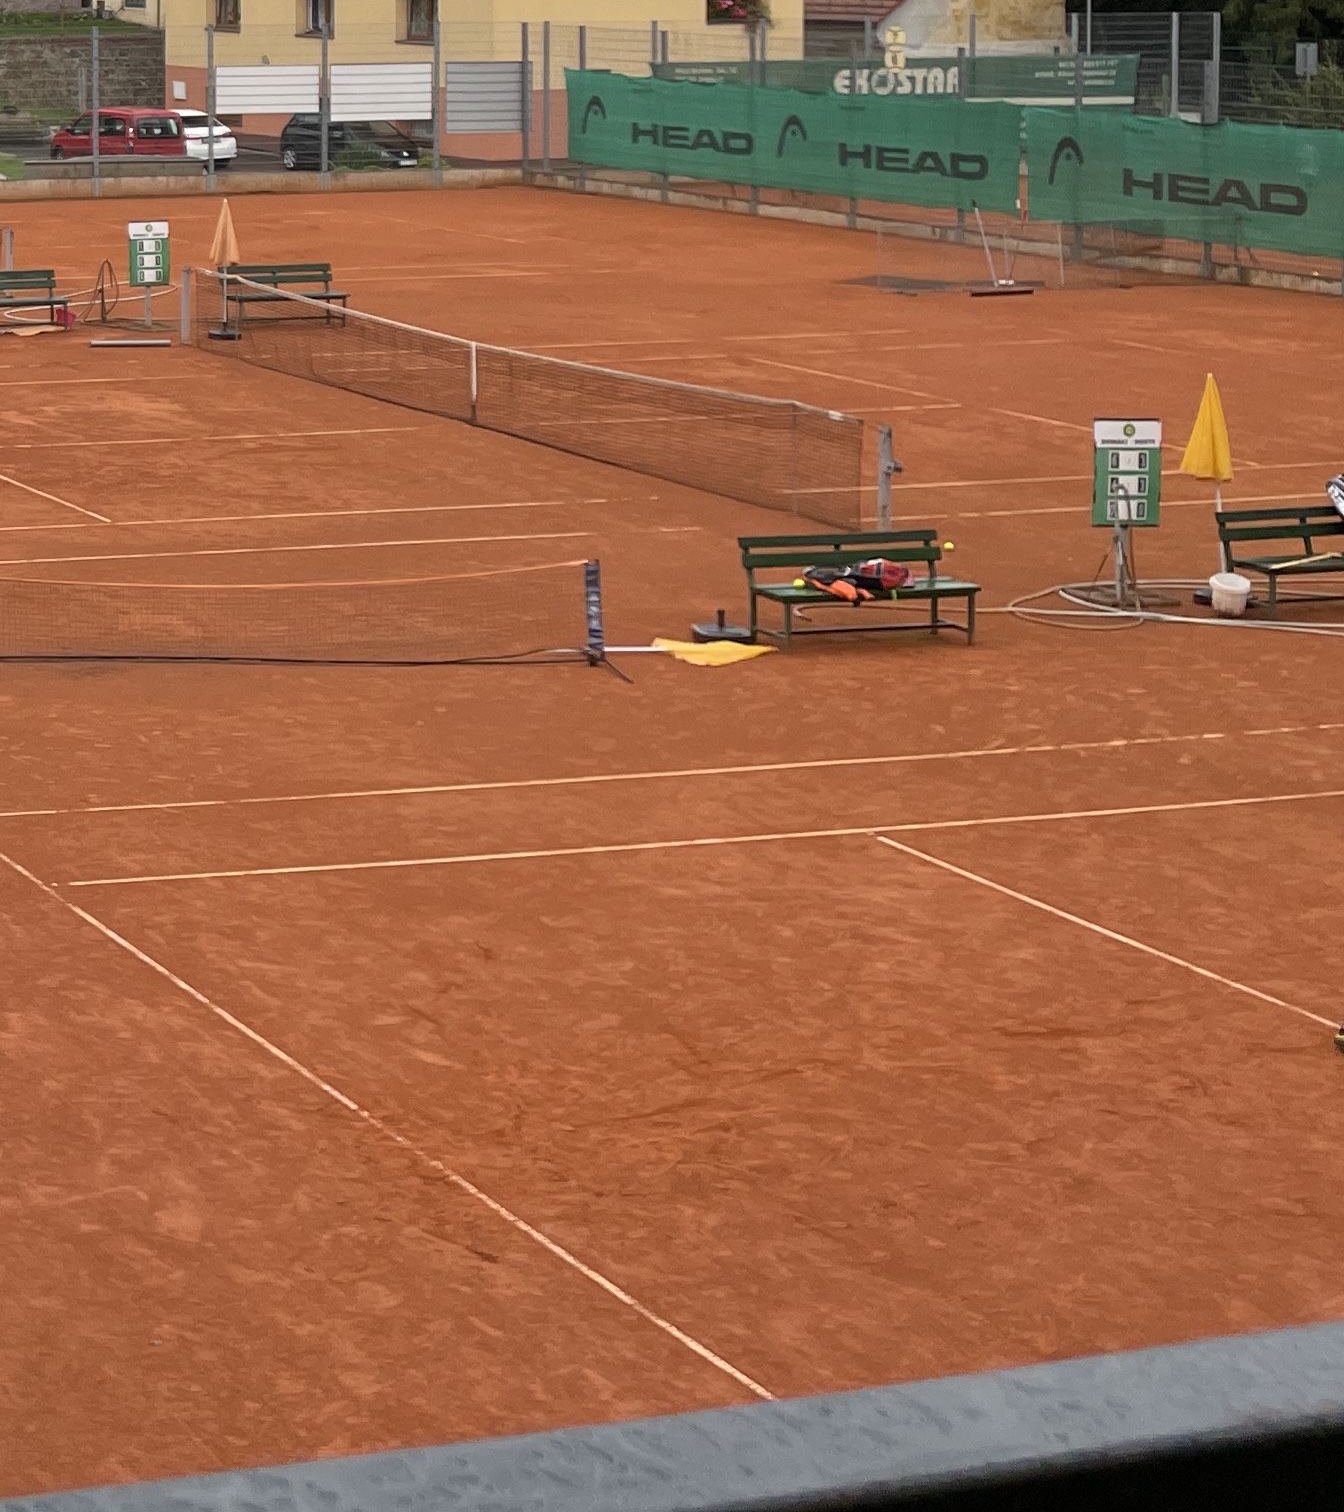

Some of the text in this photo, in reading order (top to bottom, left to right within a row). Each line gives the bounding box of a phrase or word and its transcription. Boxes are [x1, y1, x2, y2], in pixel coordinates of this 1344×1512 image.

[632, 122, 754, 156] HEAD
[838, 142, 989, 180] HEAD
[1122, 168, 1309, 216] HEAD
